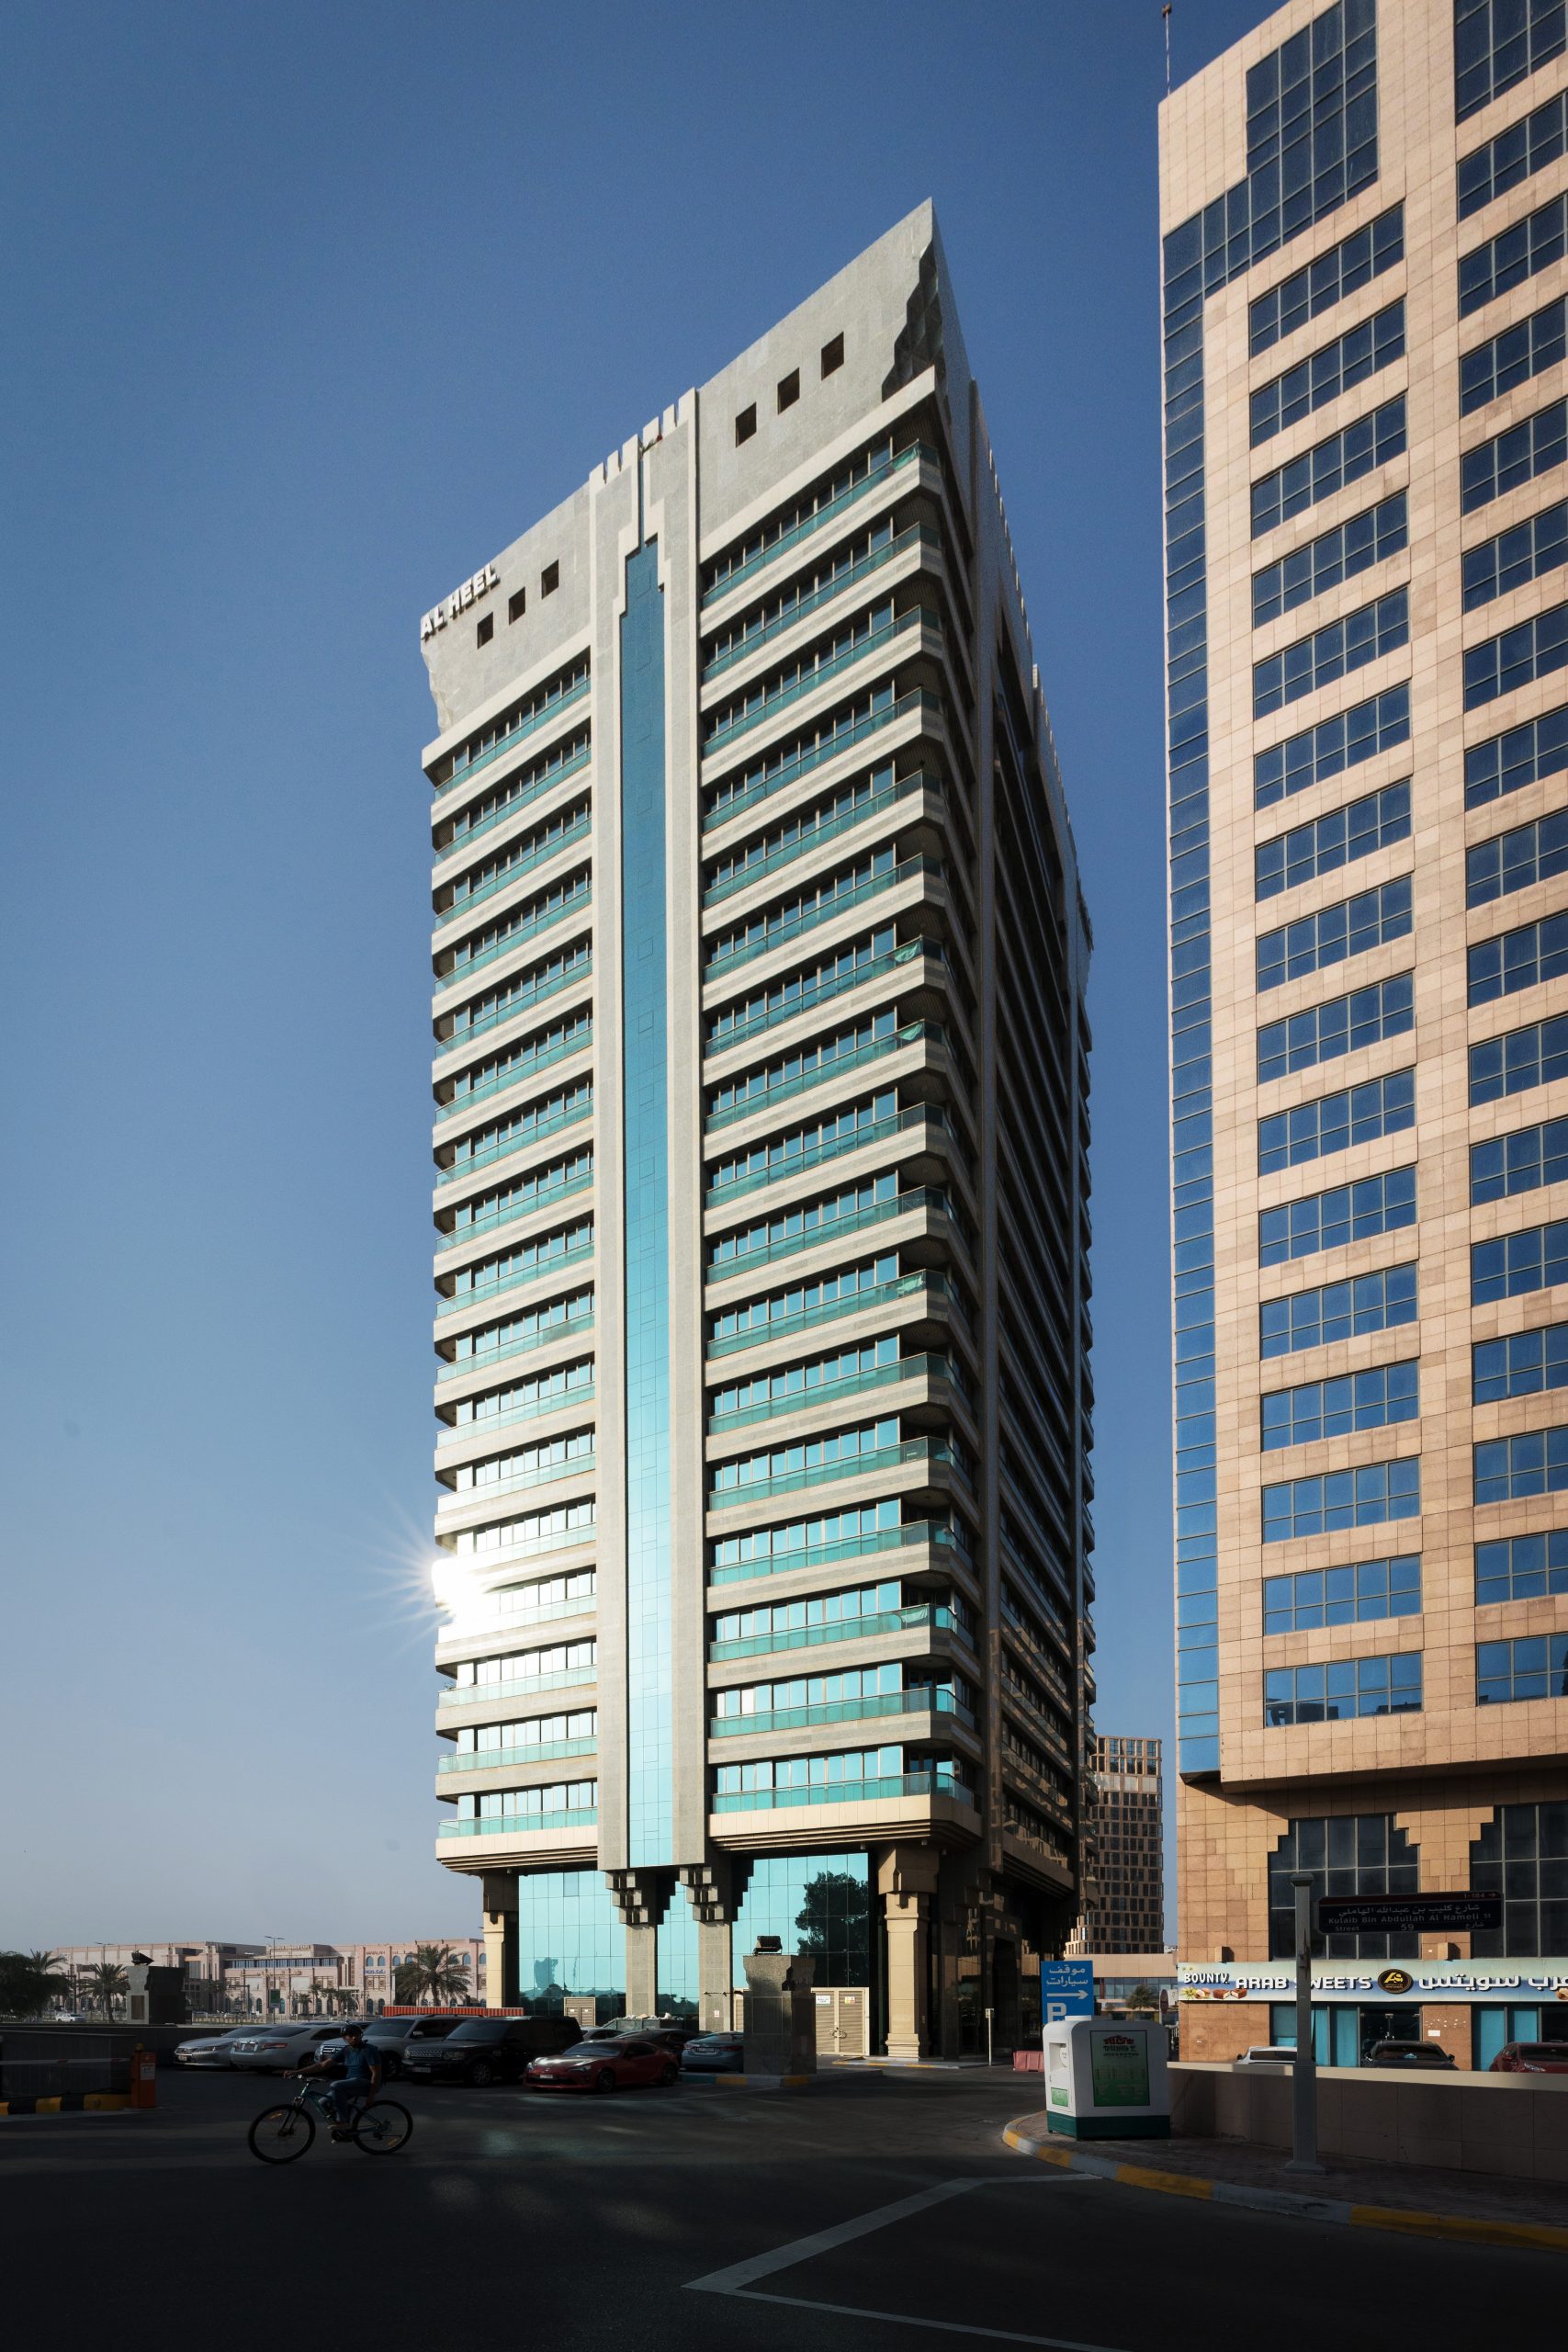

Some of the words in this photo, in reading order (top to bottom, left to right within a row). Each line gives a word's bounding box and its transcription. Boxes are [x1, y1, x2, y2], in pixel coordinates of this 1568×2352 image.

[421, 605, 445, 639] AL
[447, 563, 497, 617] HEEL
[1412, 1905, 1426, 1915] بن
[1455, 1903, 1482, 1914] شارع
[1381, 1914, 1425, 1923] Abdullah
[1428, 1913, 1439, 1921] Al
[1443, 1912, 1480, 1921] Hameli
[1401, 1923, 1415, 1931] 59
[1049, 1964, 1086, 1975] موقف
[1046, 1975, 1089, 1987] سيارات
[1184, 1973, 1228, 1984] BOUNTY
[1235, 1976, 1288, 1989] ARAB
[1294, 1976, 1372, 1989] WEETS
[1418, 1973, 1520, 1991] سويتس
[1047, 2002, 1066, 2023] P
